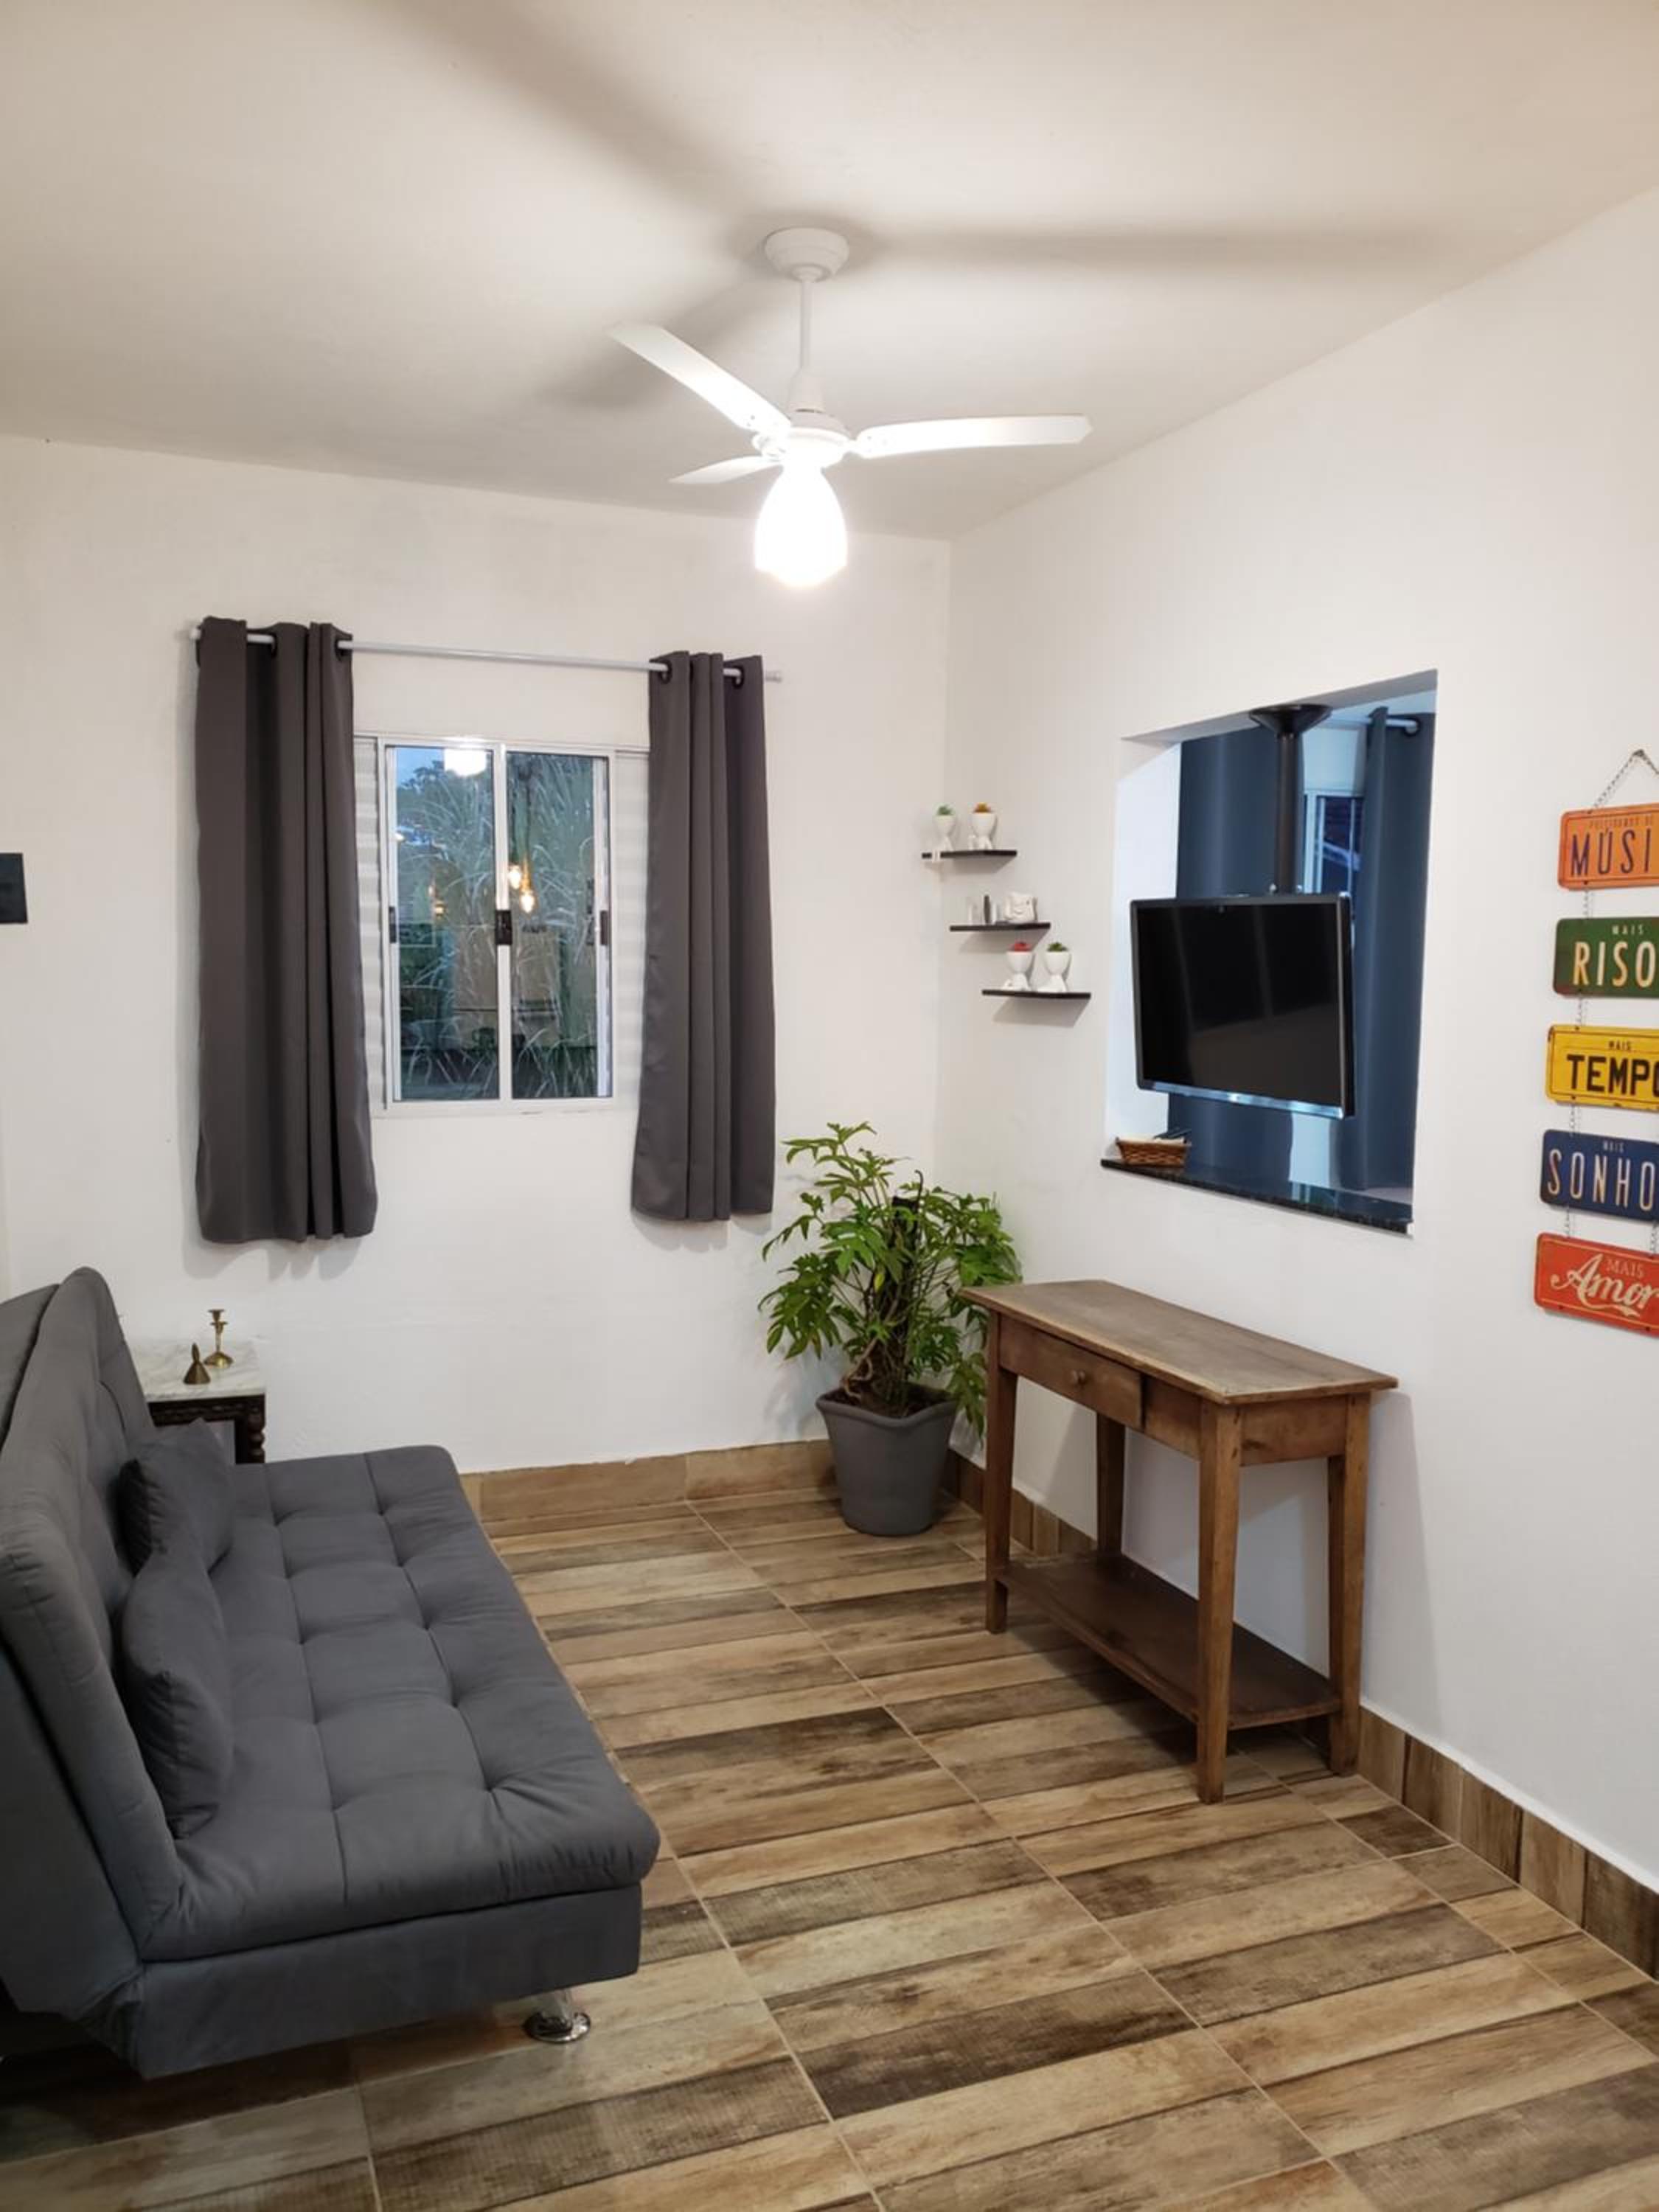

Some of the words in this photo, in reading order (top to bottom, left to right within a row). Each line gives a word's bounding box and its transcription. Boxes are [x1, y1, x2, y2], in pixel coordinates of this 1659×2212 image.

[1612, 924, 1644, 936] MAIS
[1573, 941, 1656, 987] RISO
[1548, 1148, 1655, 1211] SONHO
[1605, 1256, 1644, 1279] MAIS
